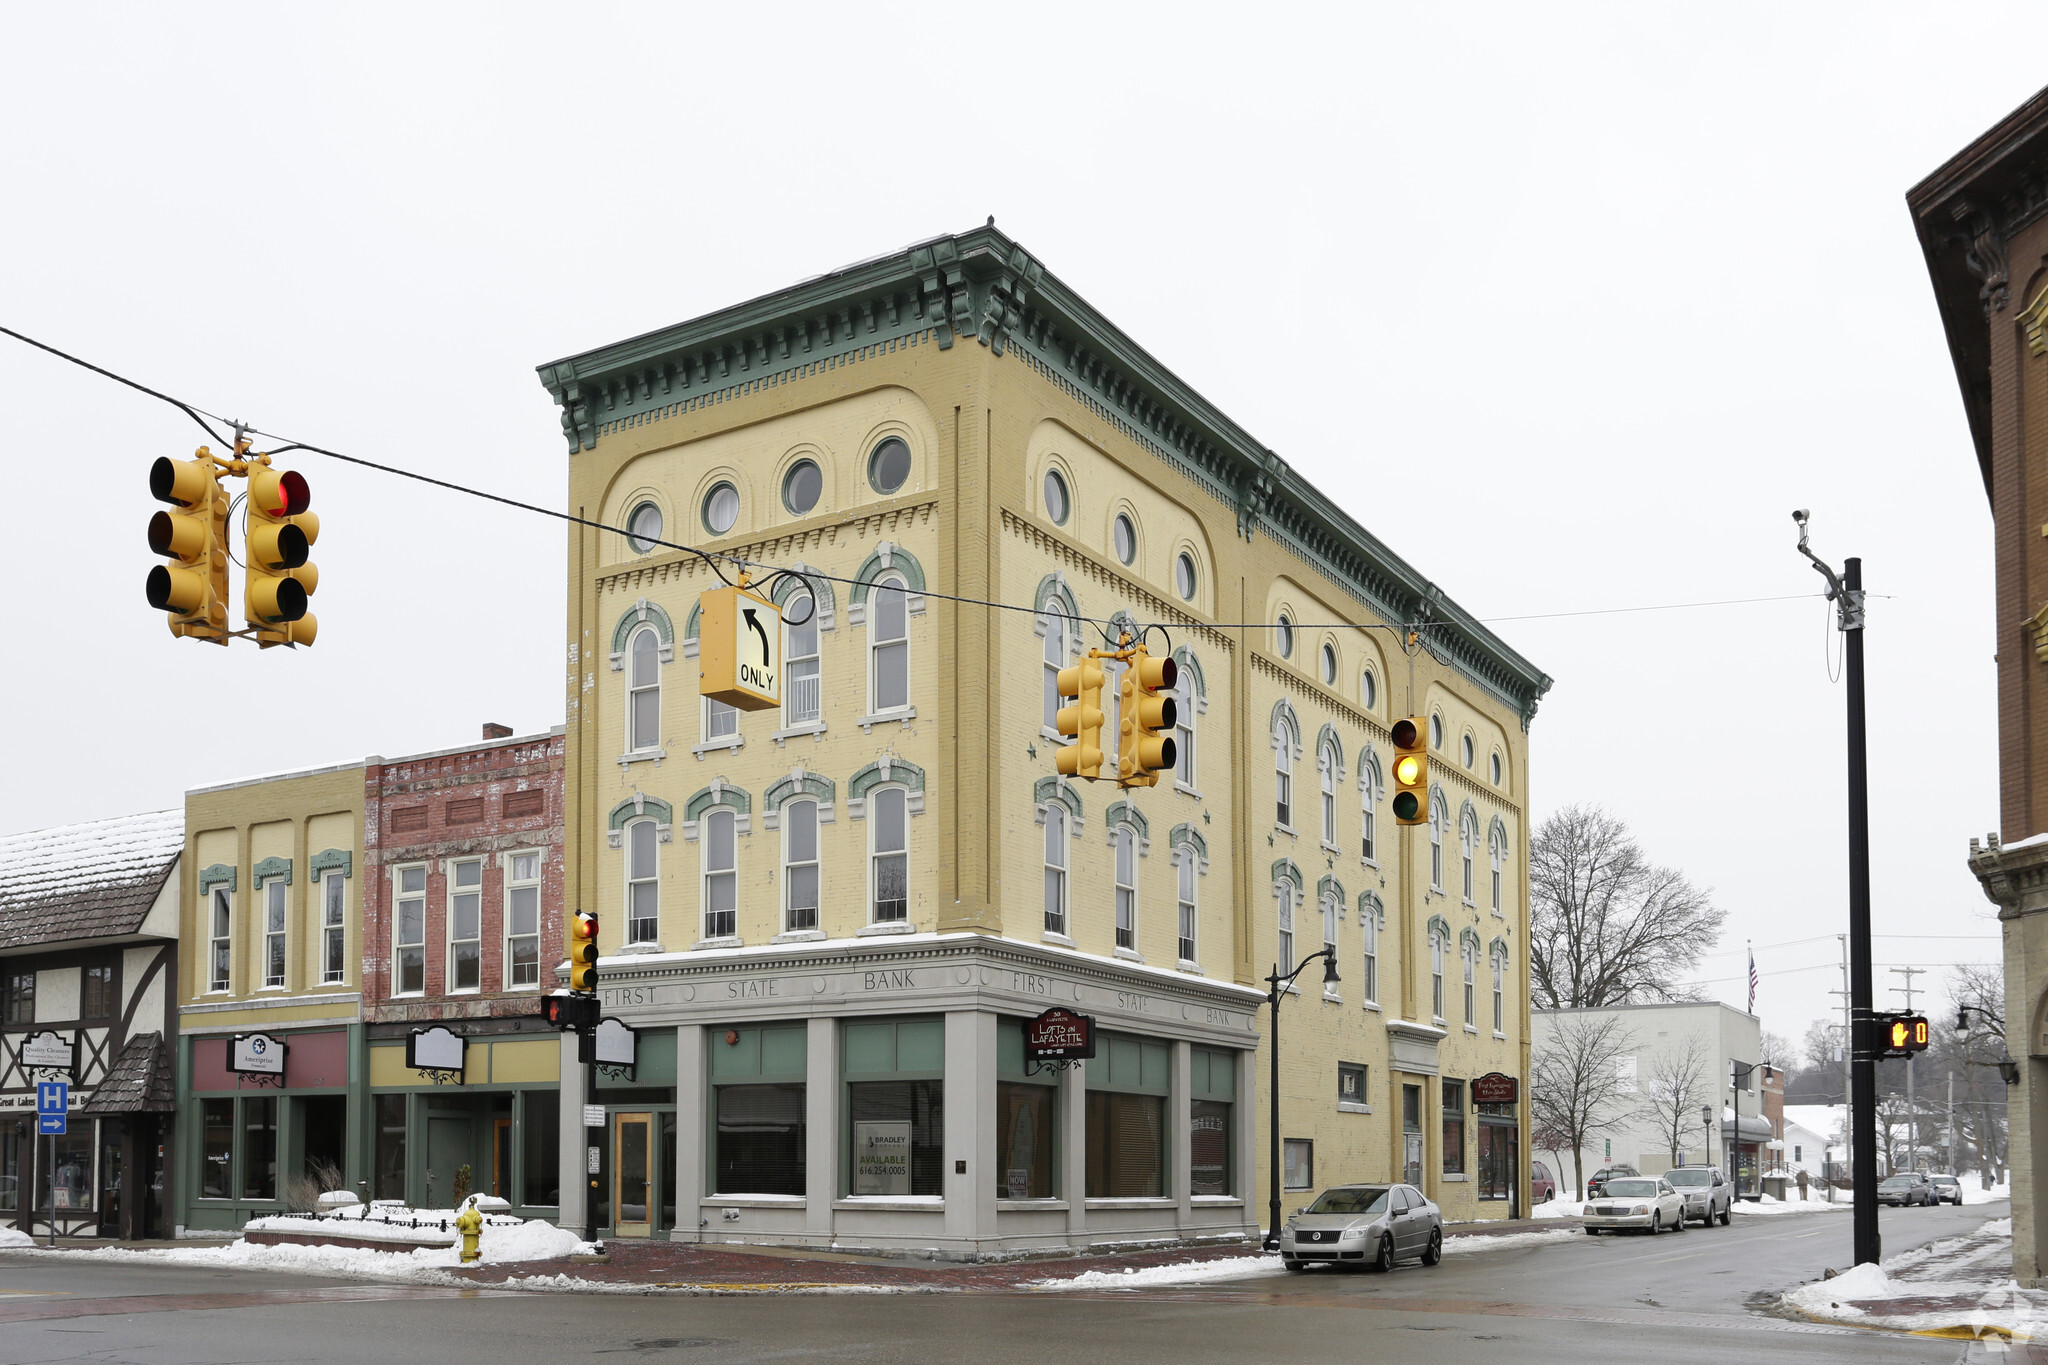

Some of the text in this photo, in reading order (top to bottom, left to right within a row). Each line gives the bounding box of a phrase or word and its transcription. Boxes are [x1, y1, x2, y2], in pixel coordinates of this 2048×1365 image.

[741, 664, 774, 691] ONLY
[604, 969, 915, 1006] FIRST STATE BANK
[1013, 972, 1230, 1026] FIRST STATE BANK
[1040, 1024, 1065, 1034] LOFTS
[1916, 1022, 1926, 1044] 0
[1032, 1033, 1083, 1044] LAFAYETTE
[25, 1046, 45, 1055] Quality
[244, 1055, 273, 1064] Ameriprise
[18, 1097, 36, 1106] Lakes
[43, 1086, 62, 1109] H
[875, 1136, 906, 1144] BRADLEY
[860, 1155, 906, 1165] AVAILABLE
[859, 1166, 906, 1175] 616.254.0005
[1010, 1176, 1026, 1184] NOW
